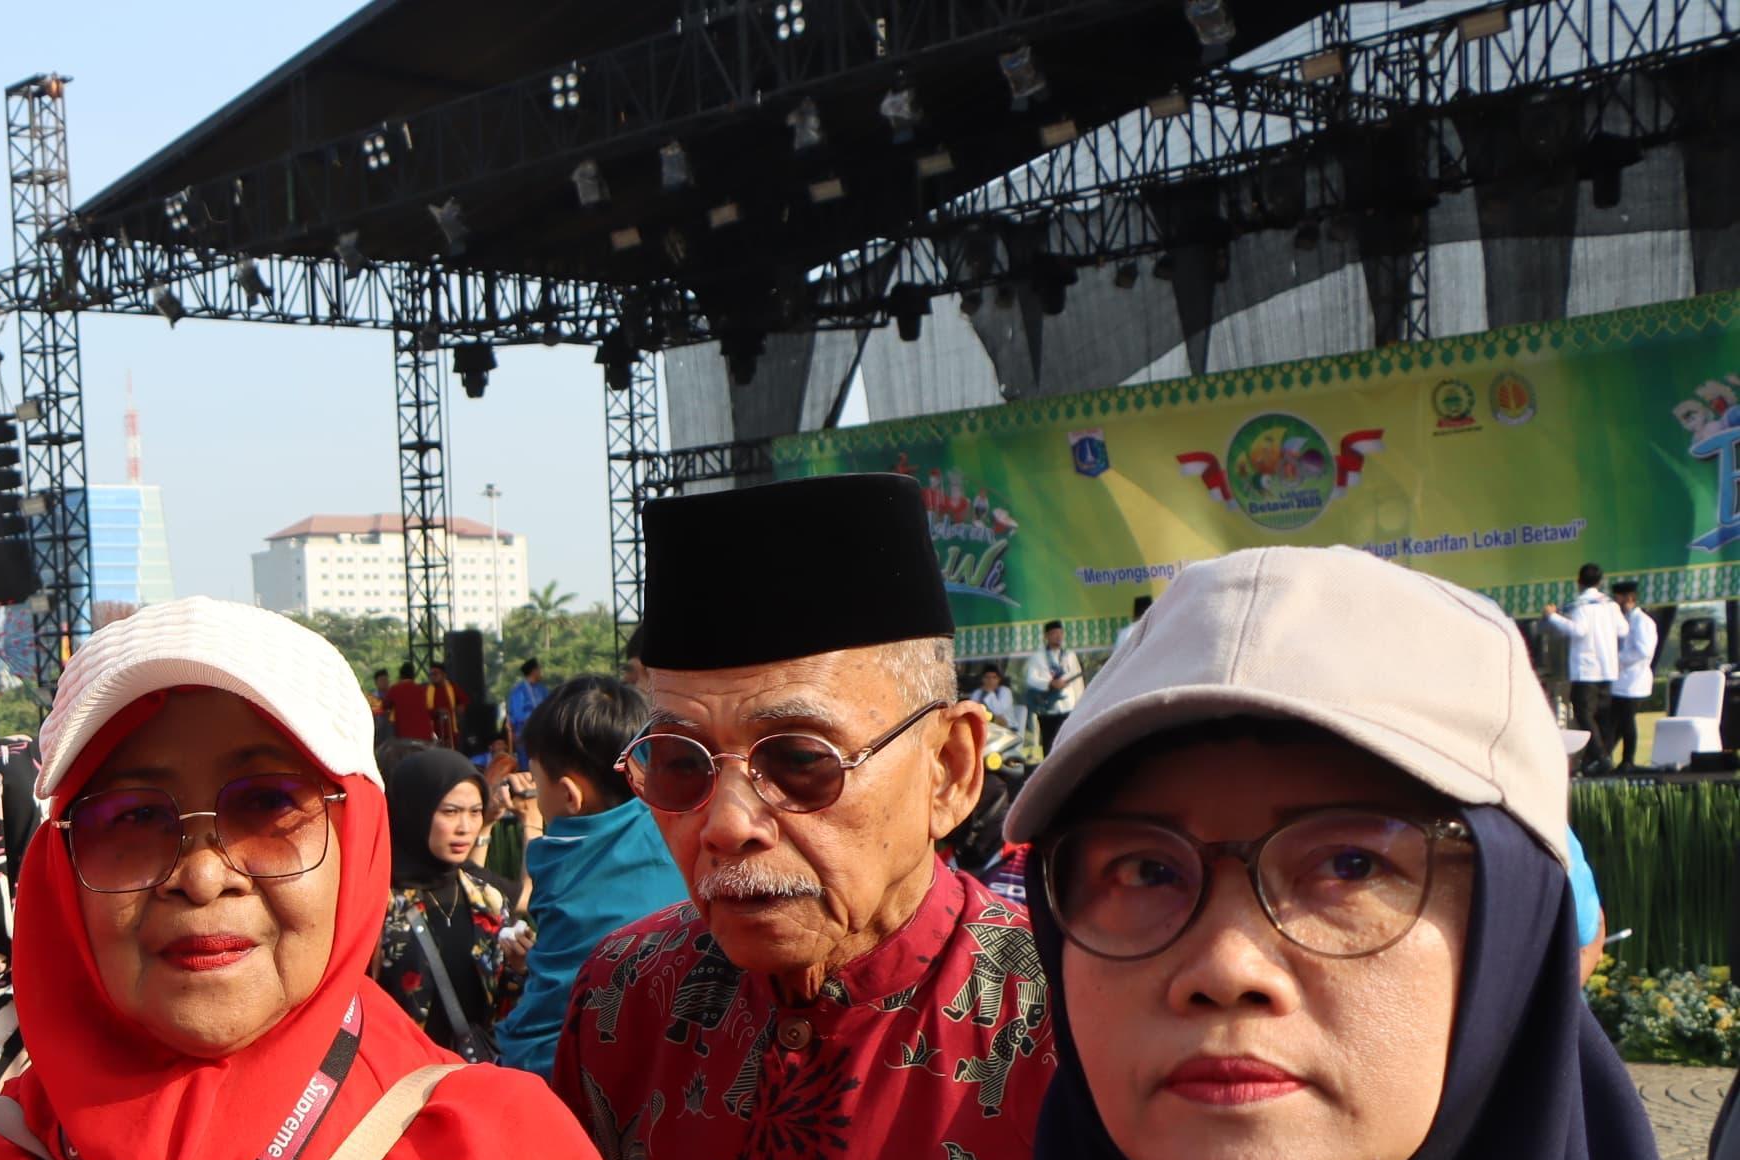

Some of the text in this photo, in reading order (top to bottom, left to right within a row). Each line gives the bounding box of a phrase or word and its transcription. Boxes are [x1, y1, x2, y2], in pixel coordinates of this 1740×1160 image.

[1402, 534, 1469, 556] Kearifan
[1473, 528, 1517, 549] Lokal
[267, 1076, 329, 1159] Supreme
